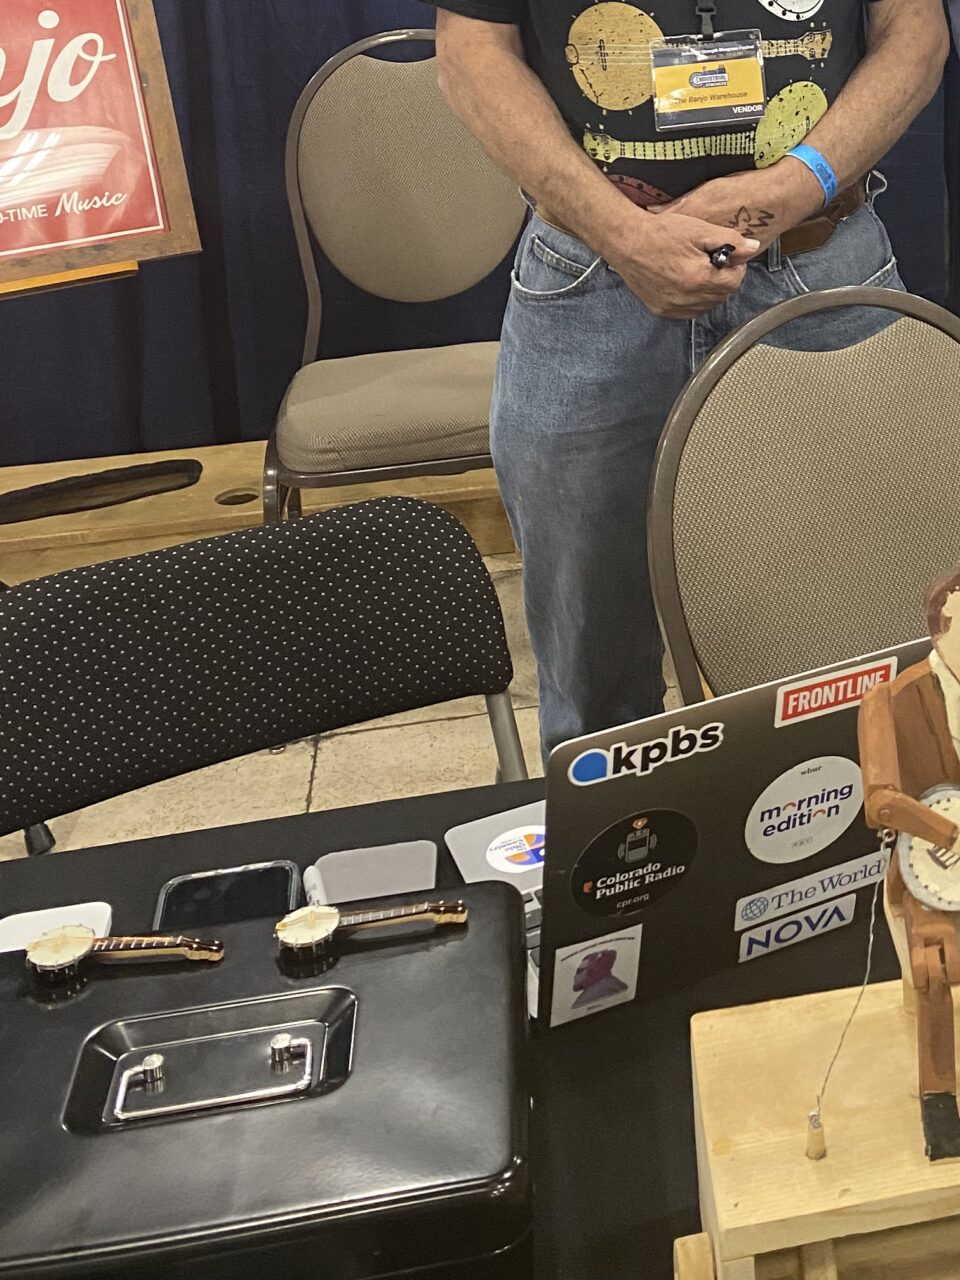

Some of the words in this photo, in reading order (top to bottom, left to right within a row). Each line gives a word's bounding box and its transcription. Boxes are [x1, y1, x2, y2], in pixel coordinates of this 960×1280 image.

[0, 9, 117, 140] jo
[688, 95, 707, 105] Banjo
[710, 91, 748, 101] Warehouse
[732, 105, 763, 114] VENDOR
[0, 204, 48, 223] -TIME
[55, 191, 128, 217] Music
[786, 669, 886, 715] FRONTLINE
[612, 725, 720, 774] kpbs
[800, 764, 822, 776] wbur
[595, 878, 641, 899] Public
[644, 863, 686, 887] Radio
[596, 861, 661, 888] Colorado
[771, 886, 817, 912] The
[819, 859, 884, 895] World
[616, 893, 650, 909] cpr.org
[746, 905, 847, 956] NOVA
